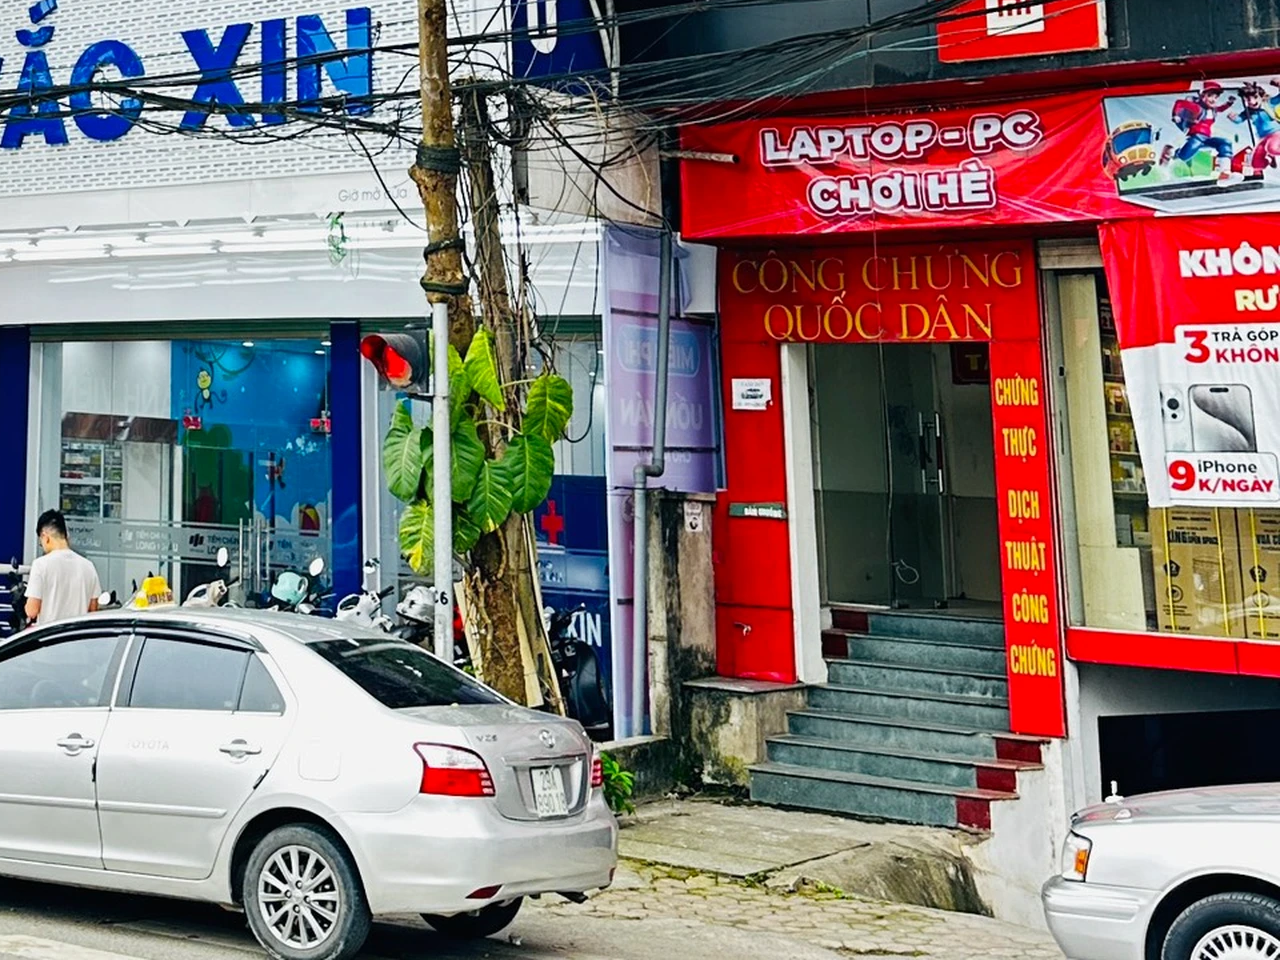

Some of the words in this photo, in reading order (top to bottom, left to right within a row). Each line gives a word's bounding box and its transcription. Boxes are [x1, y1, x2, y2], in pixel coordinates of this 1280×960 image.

[180, 6, 373, 132] XIN
[760, 123, 937, 165] LAPTOP
[969, 111, 1040, 152] PC
[809, 170, 919, 213] CHƠI
[924, 159, 995, 210] HÈ
[732, 249, 846, 294] CÔNG
[862, 245, 1022, 291] CHỨNG
[763, 290, 884, 342] QUỐC
[898, 294, 993, 340] DÂN
[1183, 330, 1210, 364] 3
[1212, 326, 1243, 342] TRẢ
[1247, 326, 1279, 342] GÓP
[994, 373, 1039, 407] CHỨNG
[1001, 427, 1038, 463] THỰC
[1168, 459, 1196, 491] 9
[1197, 459, 1258, 474] iPhone
[1198, 474, 1274, 494] K/NGÀY
[1008, 489, 1040, 524] DỊCH
[1004, 536, 1046, 577] THUẬT
[1011, 588, 1049, 625] CÔNG
[1010, 640, 1057, 677] CHỨNG
